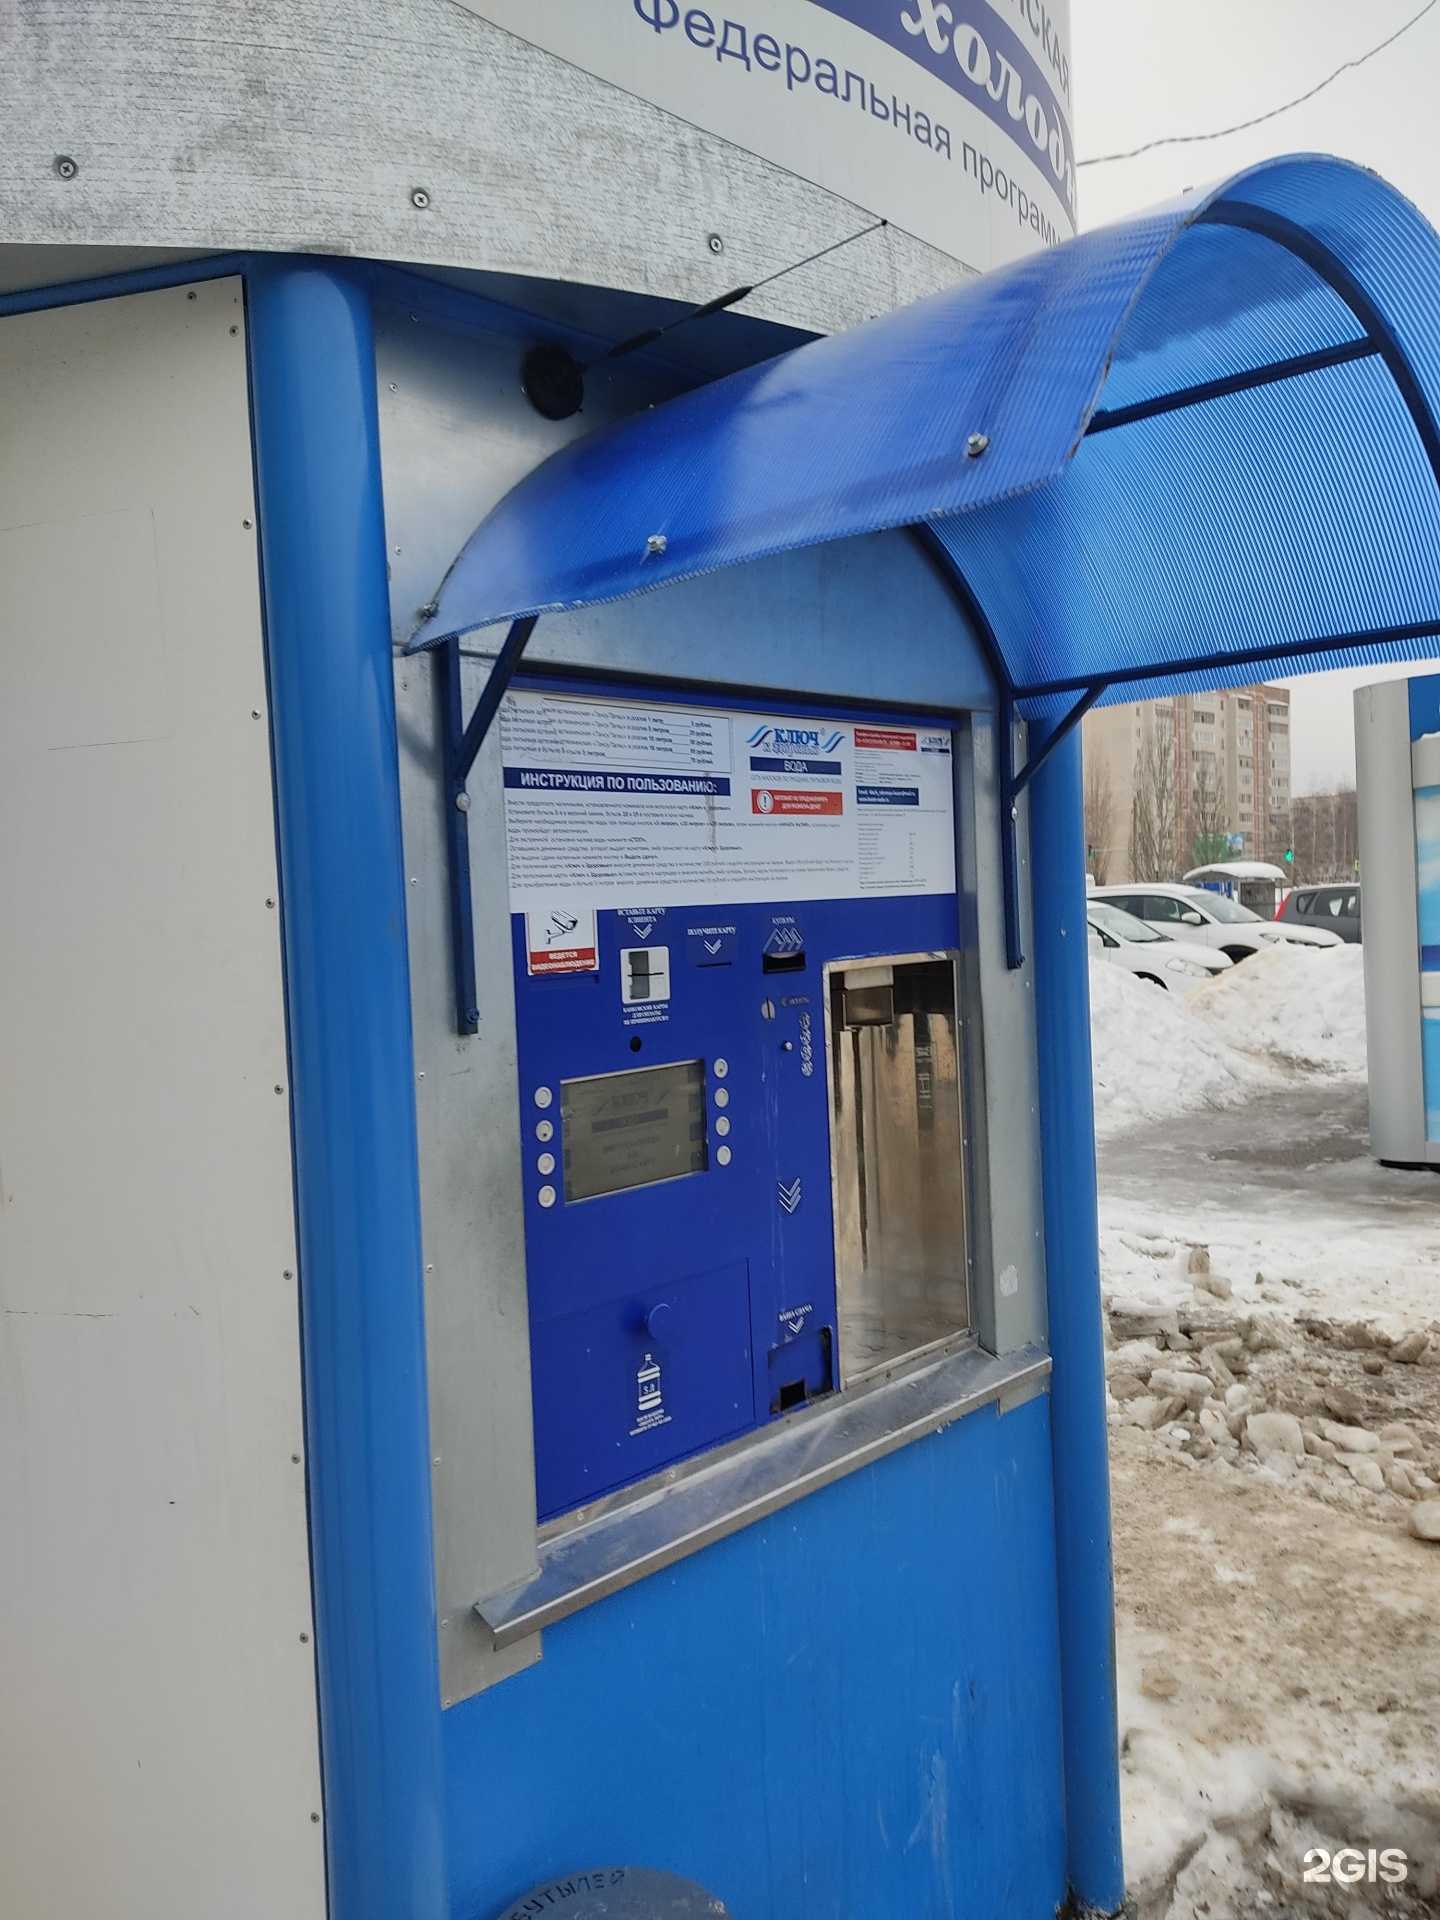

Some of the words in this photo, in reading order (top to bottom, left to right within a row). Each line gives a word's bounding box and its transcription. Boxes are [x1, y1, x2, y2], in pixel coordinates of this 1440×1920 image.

[633, 0, 953, 160] Федеральная
[774, 728, 820, 746] КЛЮЧ
[520, 772, 606, 791] ИНСТРУКЦИЯ
[607, 776, 625, 790] ПО
